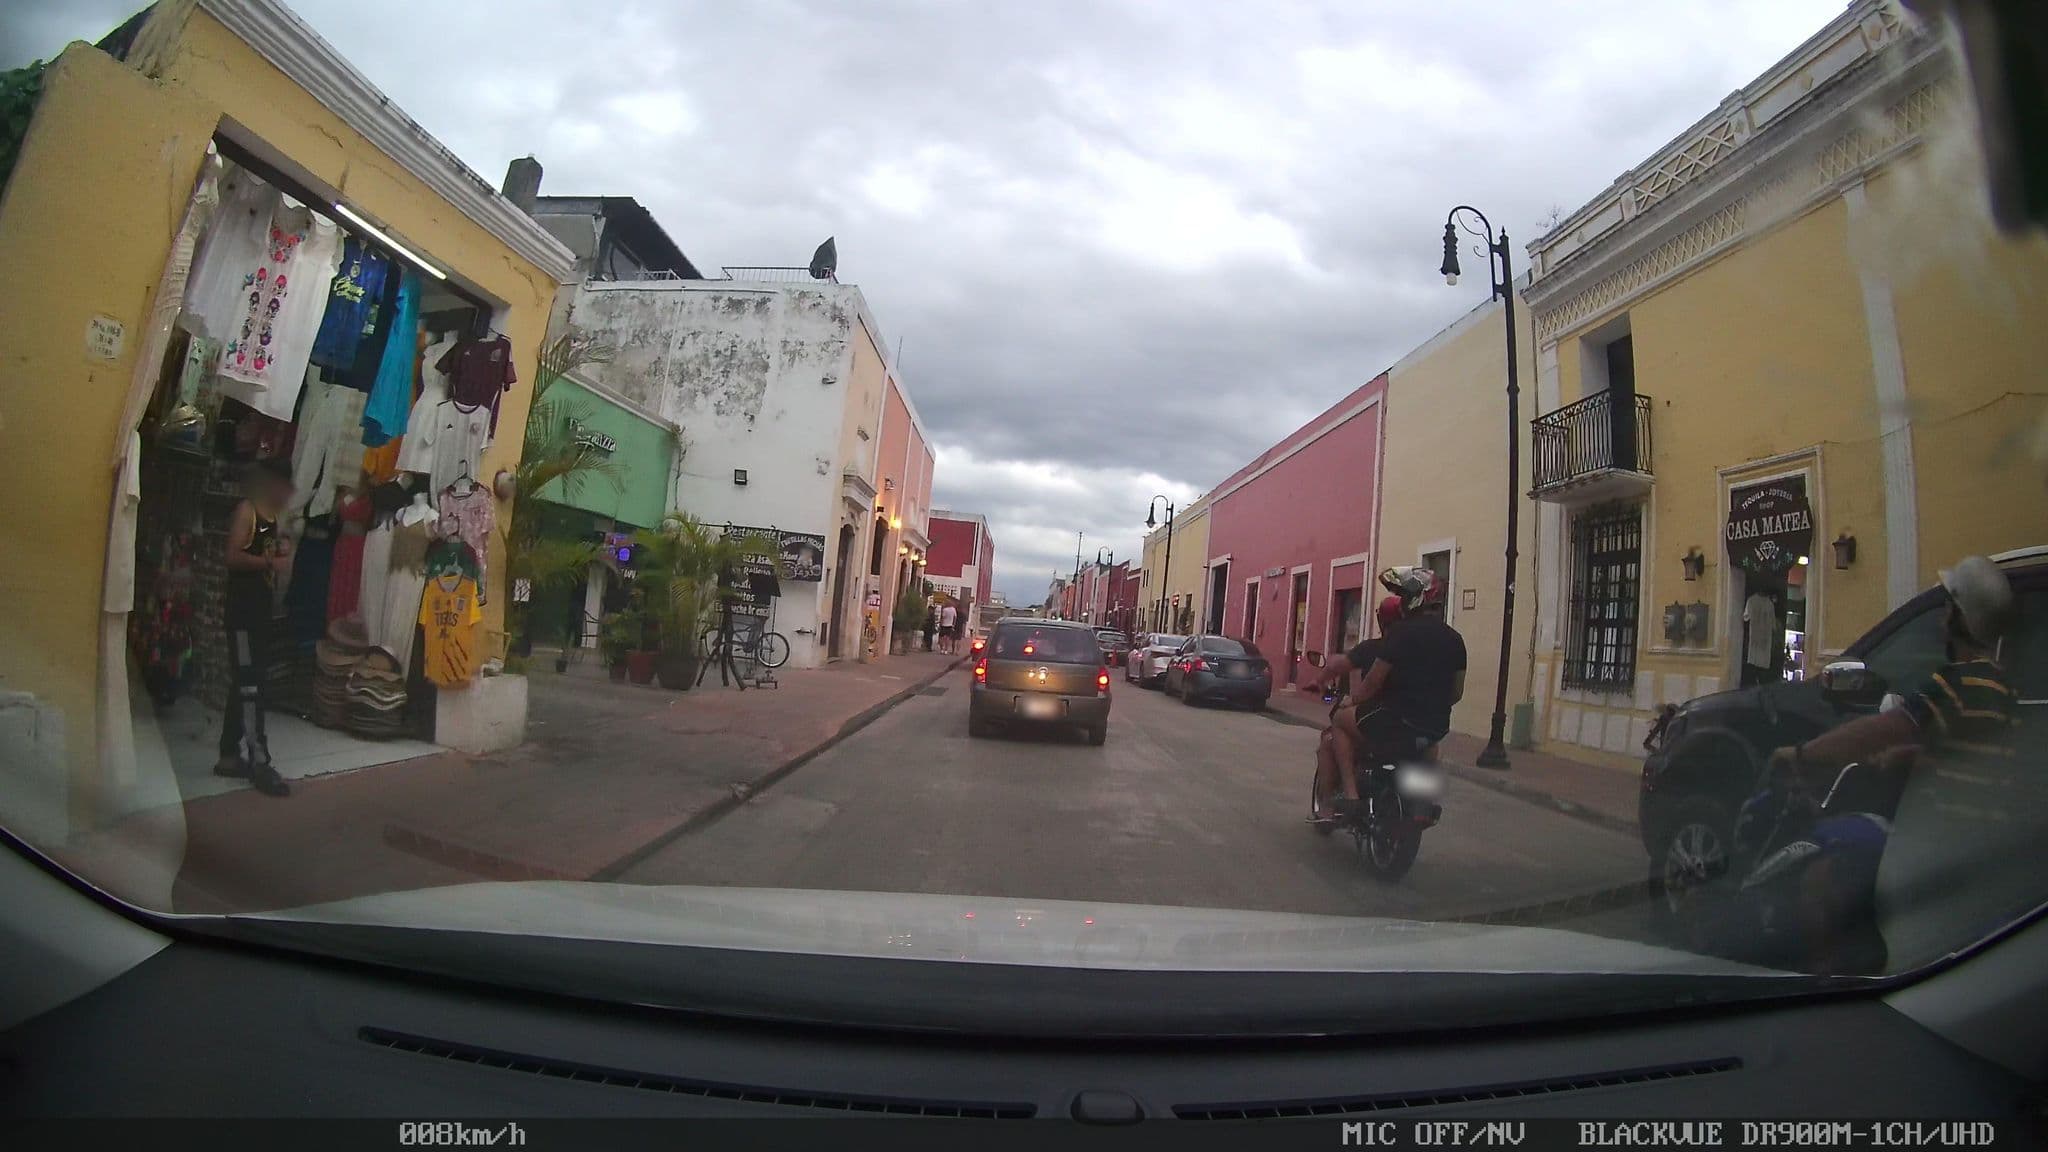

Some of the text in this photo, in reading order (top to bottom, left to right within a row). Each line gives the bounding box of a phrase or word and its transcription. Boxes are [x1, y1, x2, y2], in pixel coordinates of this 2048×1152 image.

[1742, 490, 1765, 509] TEQUILA
[1726, 510, 1811, 540] CASA MATEA
